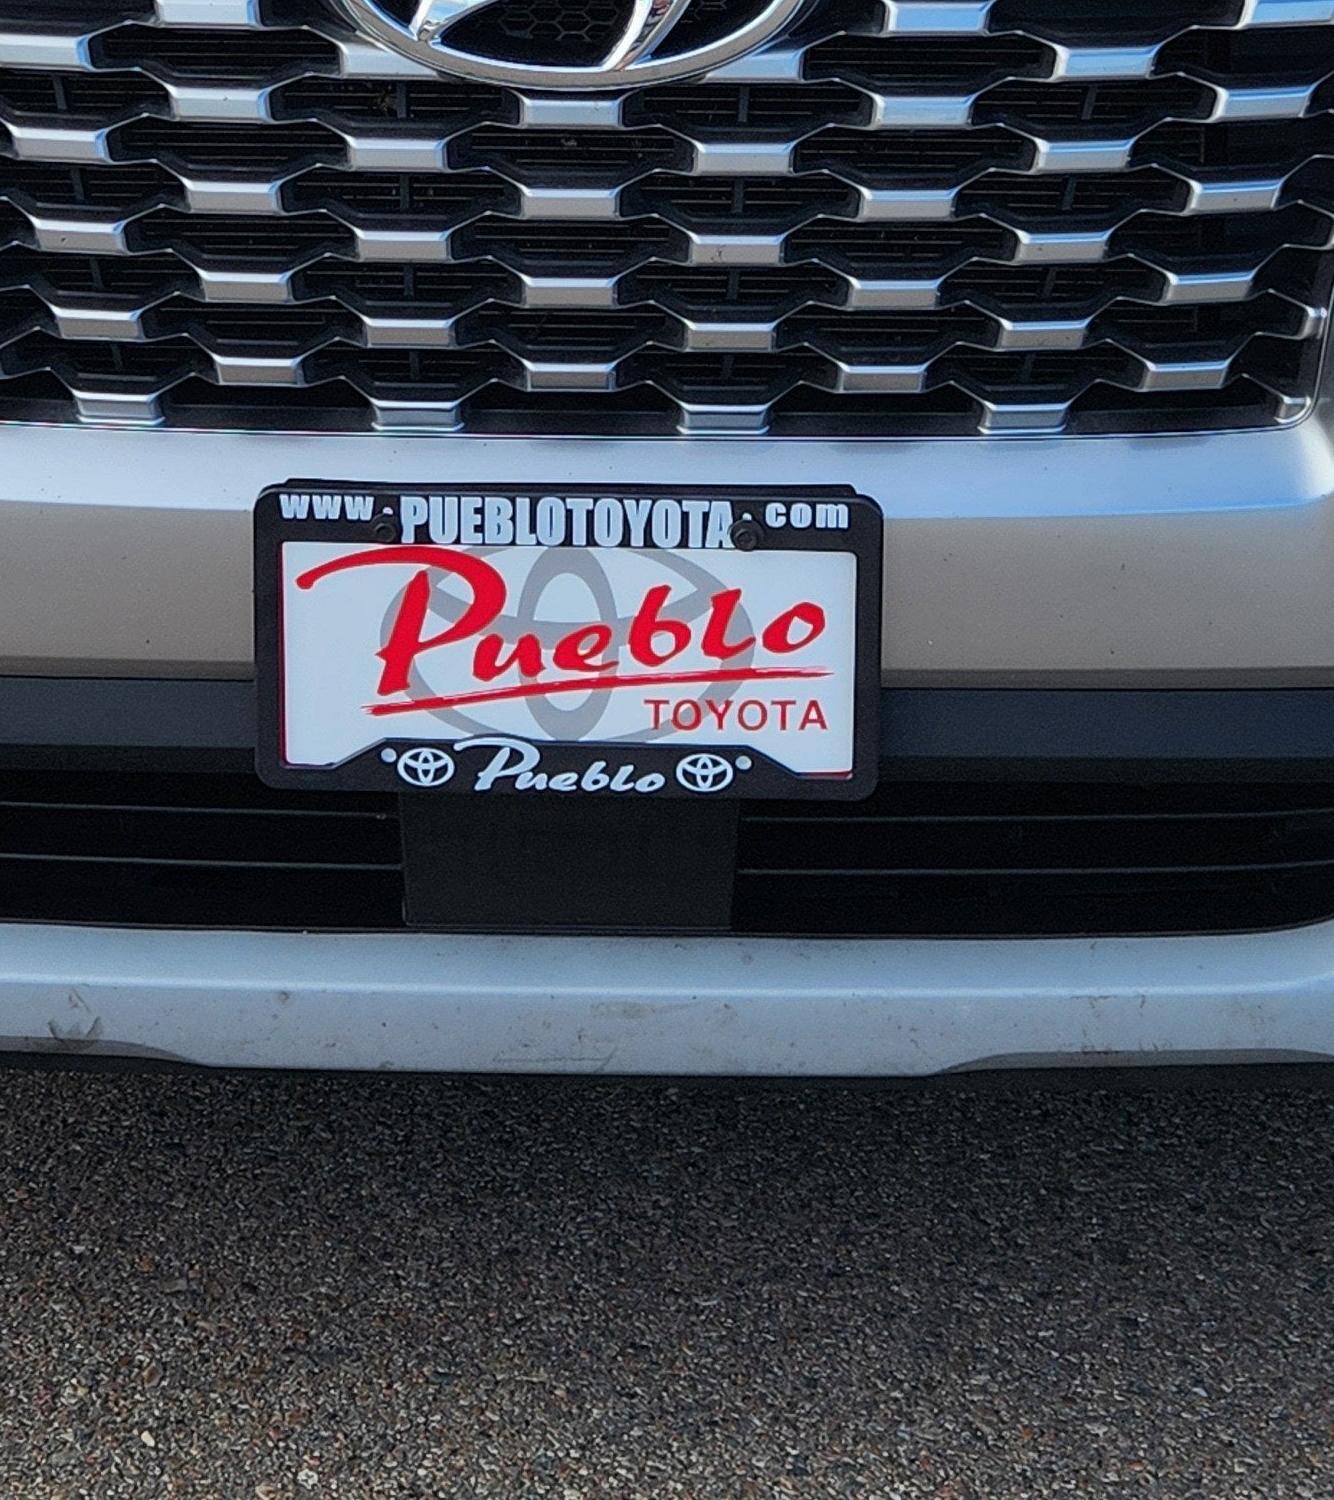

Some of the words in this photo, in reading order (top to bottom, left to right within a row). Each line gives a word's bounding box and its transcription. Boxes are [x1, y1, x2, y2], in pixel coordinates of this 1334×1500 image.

[295, 545, 826, 696] Pueblo
[643, 699, 829, 731] TOYOTA
[453, 737, 667, 793] Pueblo
